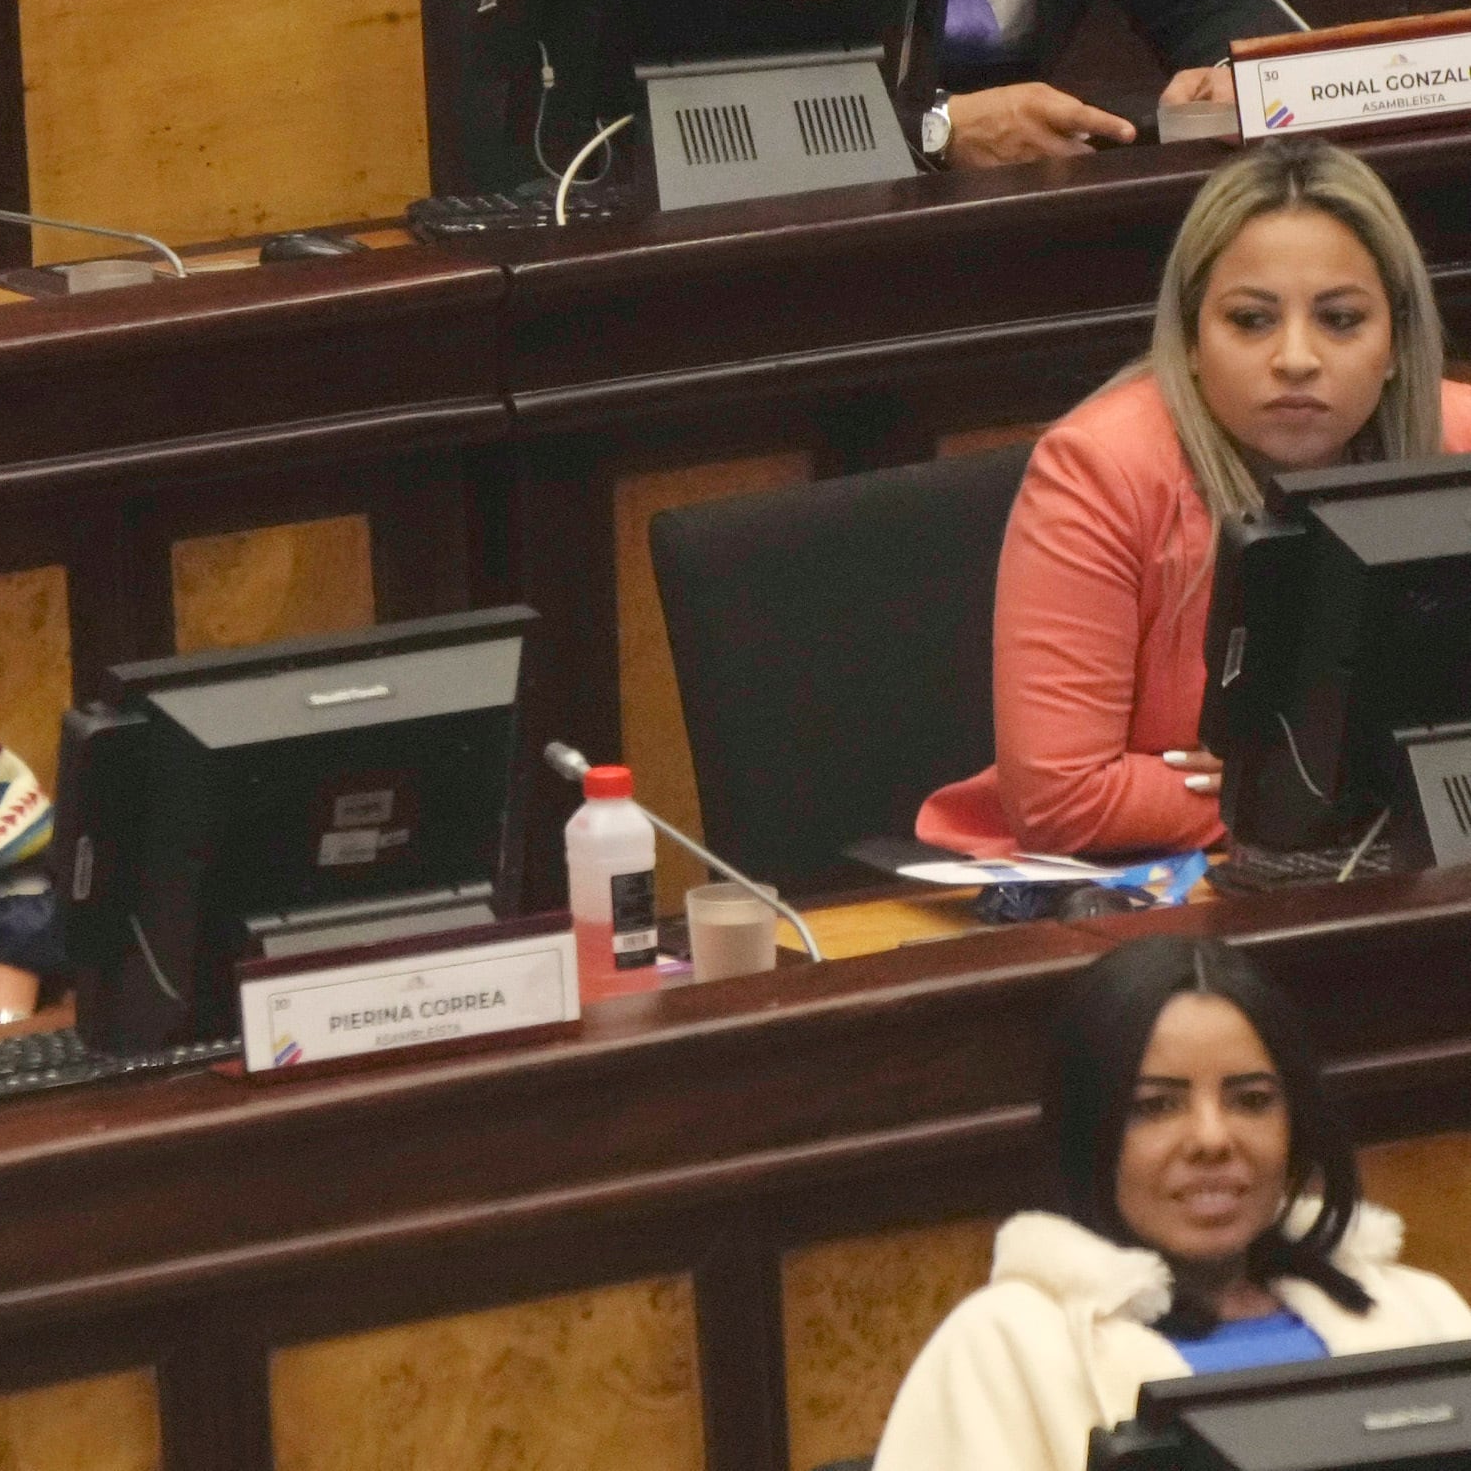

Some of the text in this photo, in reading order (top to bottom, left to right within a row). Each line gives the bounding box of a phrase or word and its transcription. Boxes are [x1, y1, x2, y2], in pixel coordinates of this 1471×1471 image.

[1263, 71, 1279, 82] 30
[1311, 65, 1471, 102] RONAL GONZAL
[329, 989, 506, 1033] PIERINA CORREA
